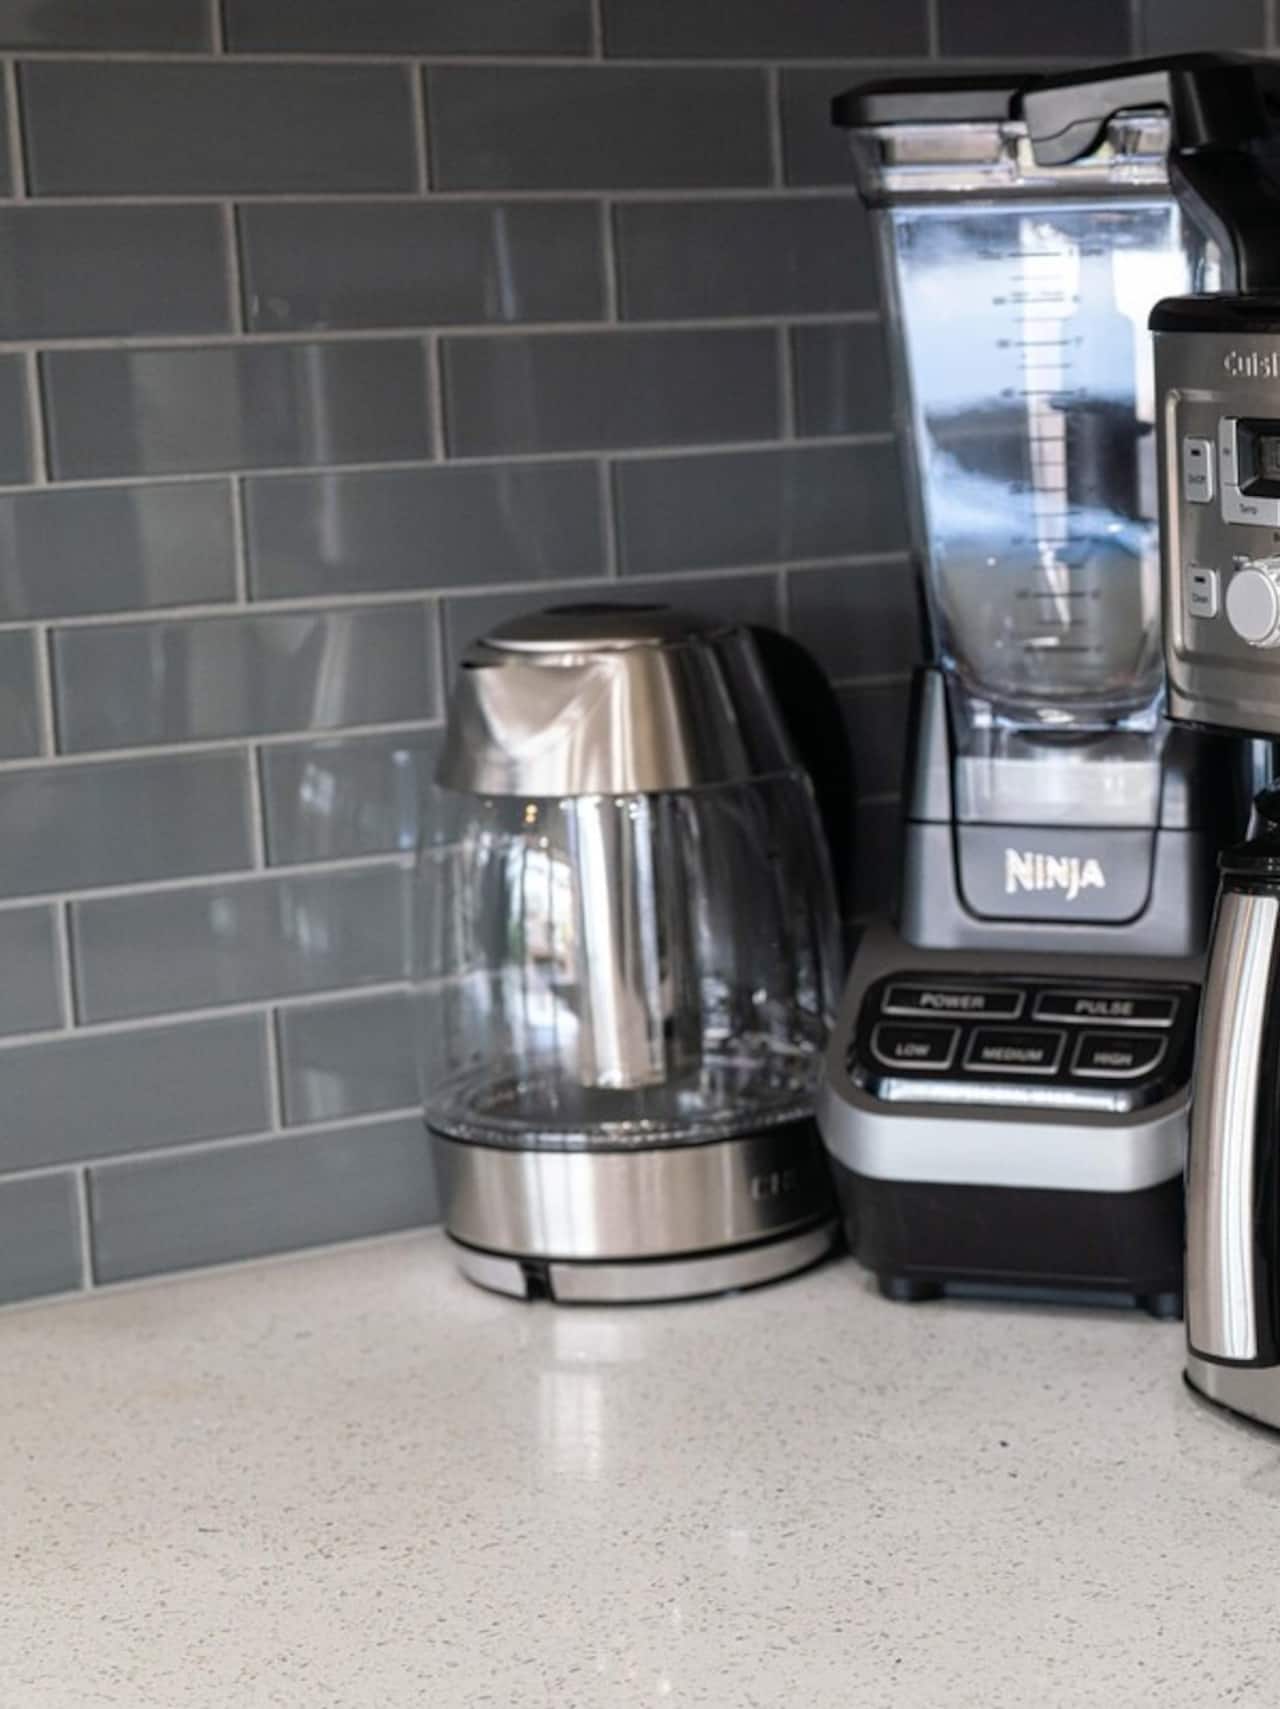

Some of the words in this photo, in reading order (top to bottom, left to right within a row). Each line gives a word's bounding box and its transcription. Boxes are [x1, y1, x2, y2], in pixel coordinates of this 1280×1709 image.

[1005, 847, 1106, 902] NINJA
[919, 992, 985, 1010] POWER
[1073, 1000, 1134, 1016] PULSE
[895, 1042, 931, 1057] LOW
[981, 1047, 1044, 1062] MEDIUM
[1092, 1052, 1134, 1067] HIGH
